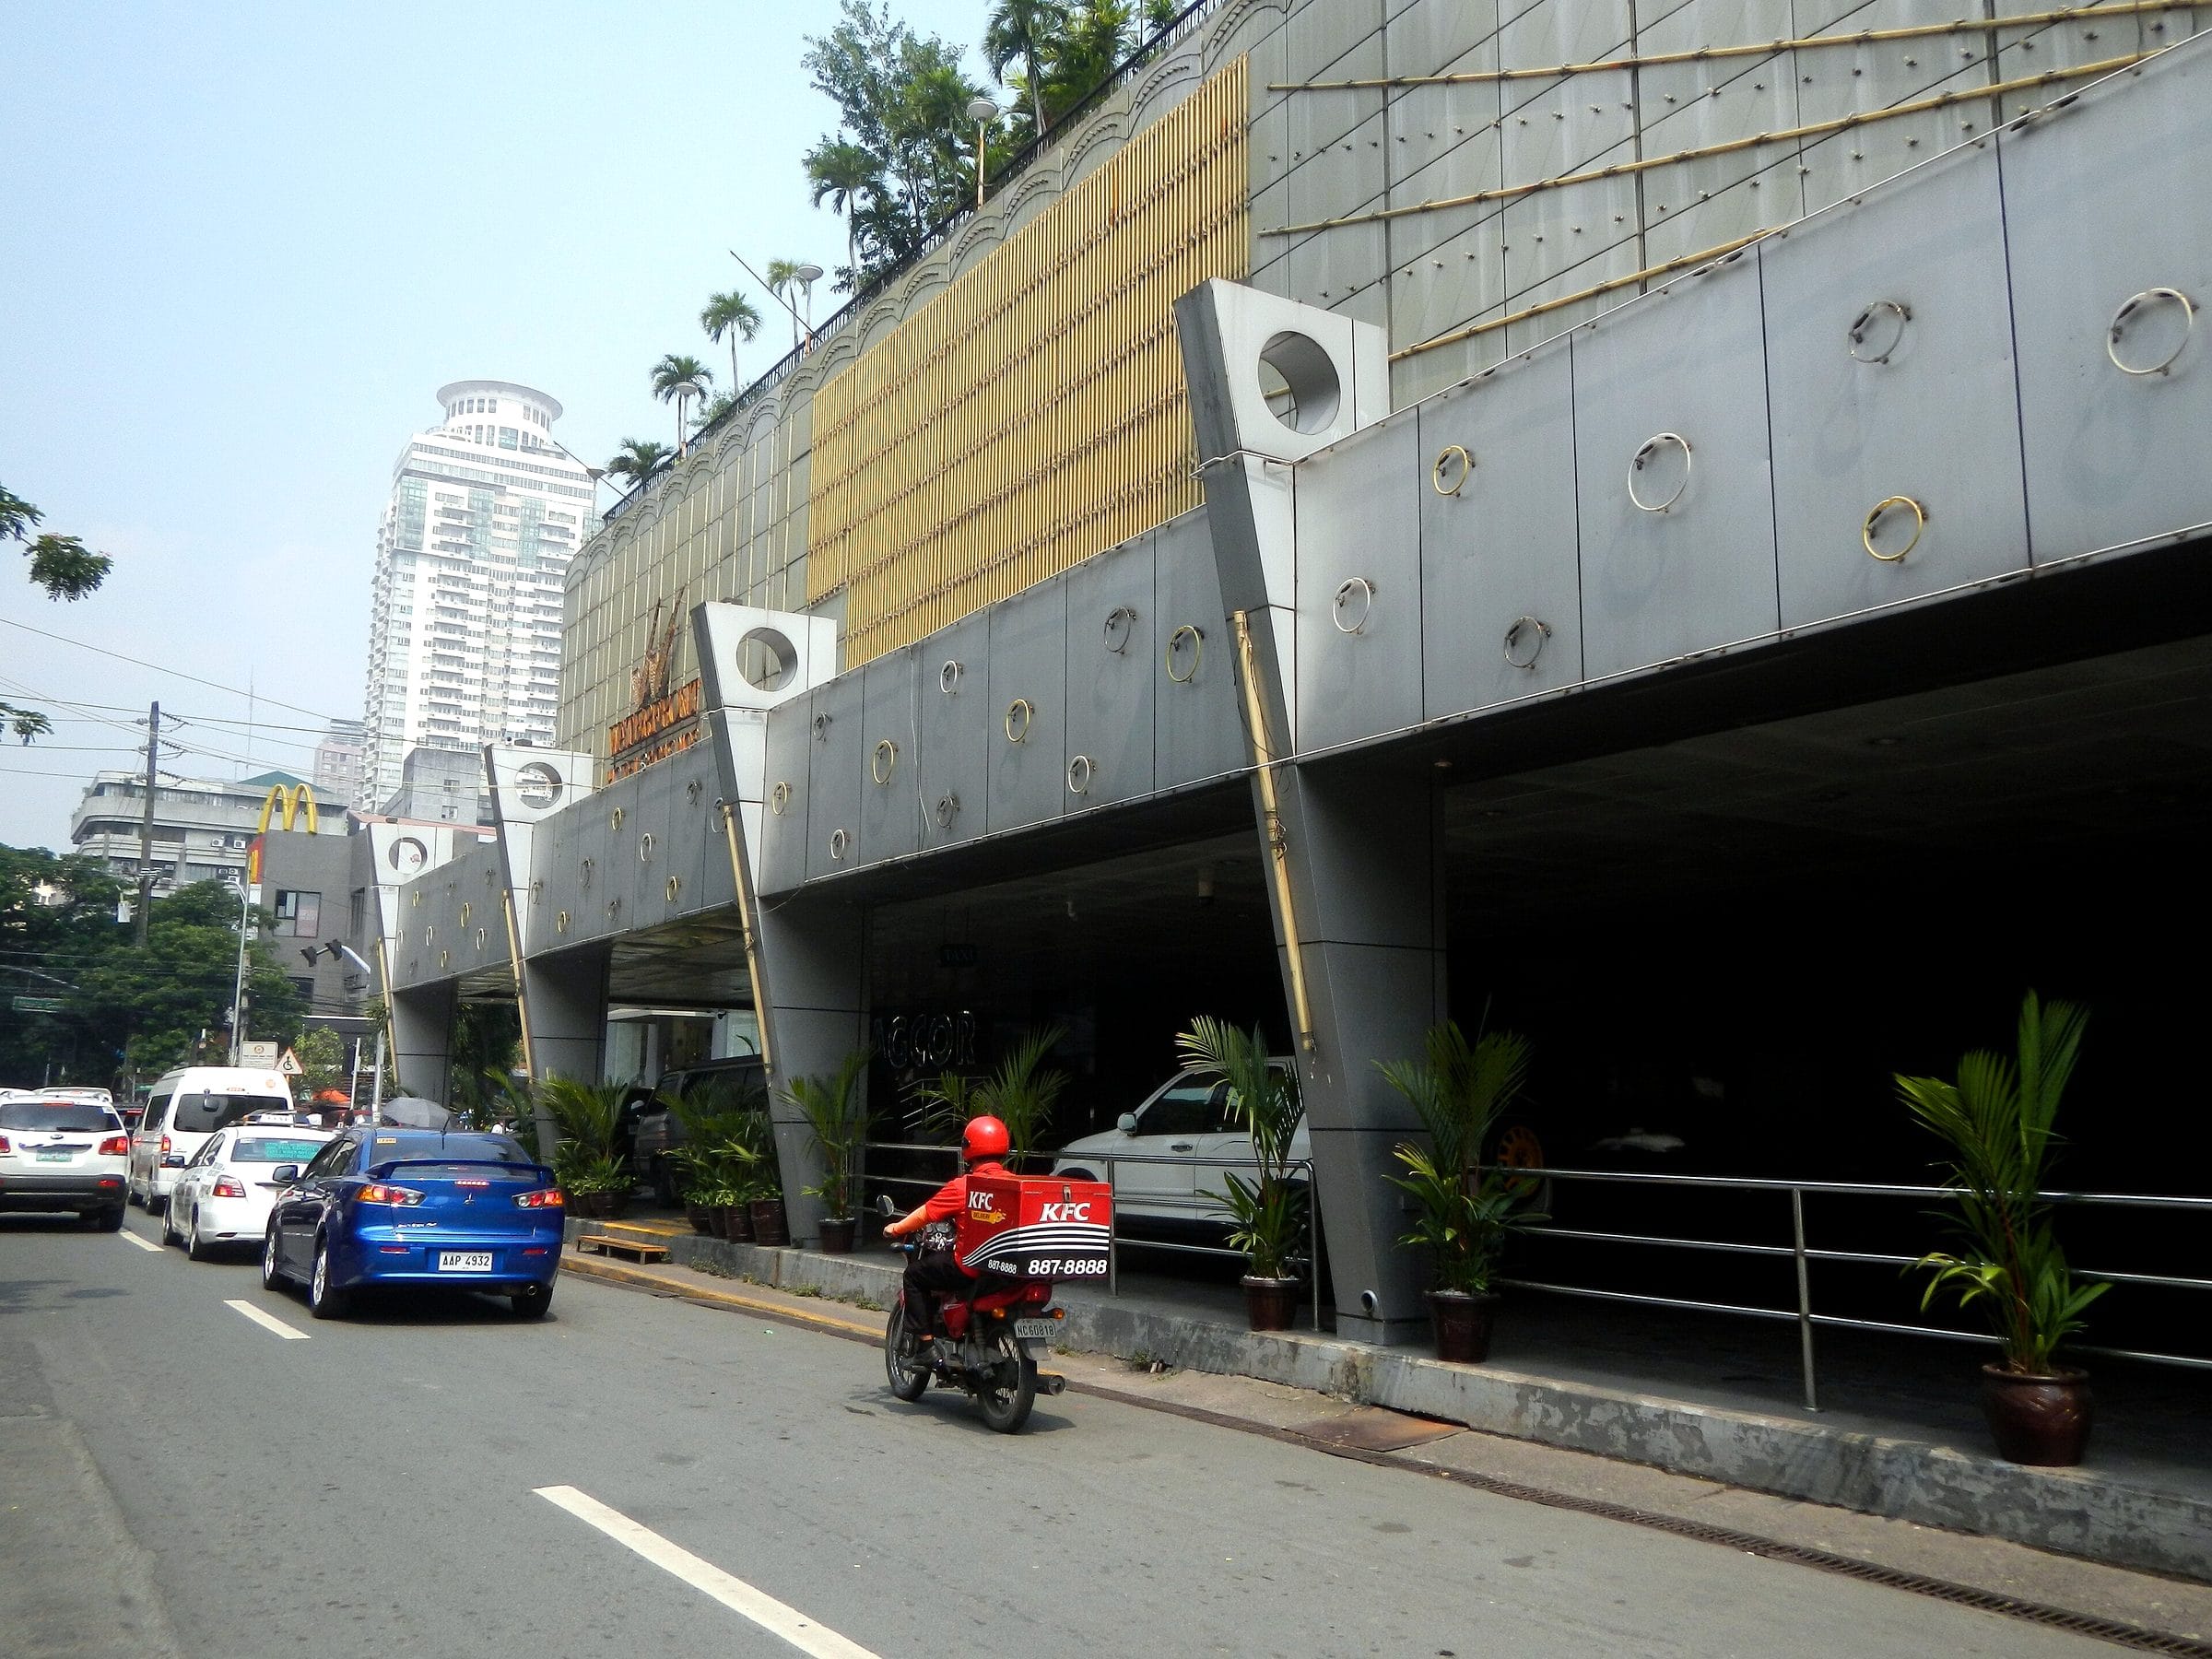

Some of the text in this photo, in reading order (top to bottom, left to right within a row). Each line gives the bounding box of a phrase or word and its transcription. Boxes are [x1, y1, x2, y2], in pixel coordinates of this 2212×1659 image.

[968, 1191, 994, 1210] KFC
[1040, 1203, 1091, 1222] KFC
[442, 1255, 490, 1266] AAP 4932
[988, 1259, 1018, 1275] 887-8888
[1028, 1259, 1108, 1275] 887-8888
